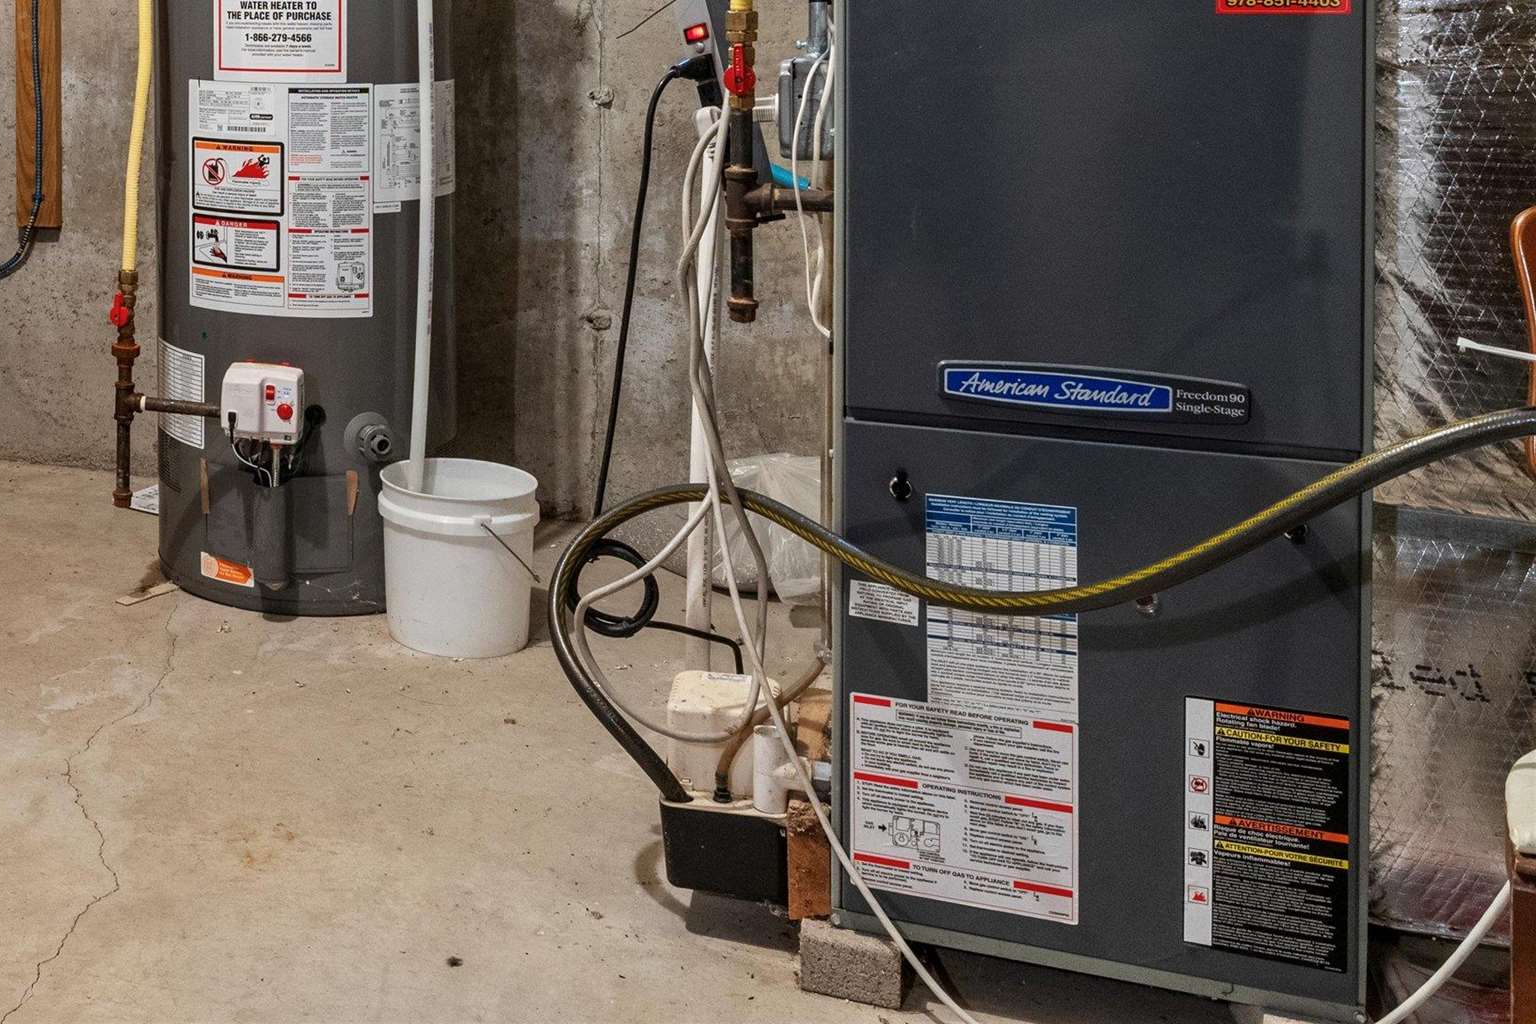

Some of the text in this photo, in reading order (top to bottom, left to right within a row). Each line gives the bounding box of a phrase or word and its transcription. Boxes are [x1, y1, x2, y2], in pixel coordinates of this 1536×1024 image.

[240, 1, 317, 10] WATER HEATER TO
[227, 11, 332, 21] THE PLACE OF PURCHASE
[245, 33, 312, 43] 1-866-279-4566
[960, 372, 1155, 408] American Standard
[1175, 401, 1246, 418] Single-Stage
[895, 701, 1029, 726] FOR YOUR SAFETY READ BEFORE OPERATING
[1216, 711, 1248, 721] Electrical
[1249, 716, 1270, 724] shock
[1255, 708, 1305, 722] WARNING
[1216, 717, 1245, 727] Rotating
[1283, 736, 1306, 747] YOUR
[1308, 739, 1341, 751] SAFETY
[922, 783, 1002, 800] OPERATING INSTRUCTIONS
[1238, 819, 1323, 840] AVERTISSEMENT
[1283, 852, 1308, 862] VOTRE
[922, 865, 938, 874] TURN
[939, 867, 951, 875] OFF
[951, 869, 965, 877] GAS
[975, 875, 1010, 885] APPLIANCE
